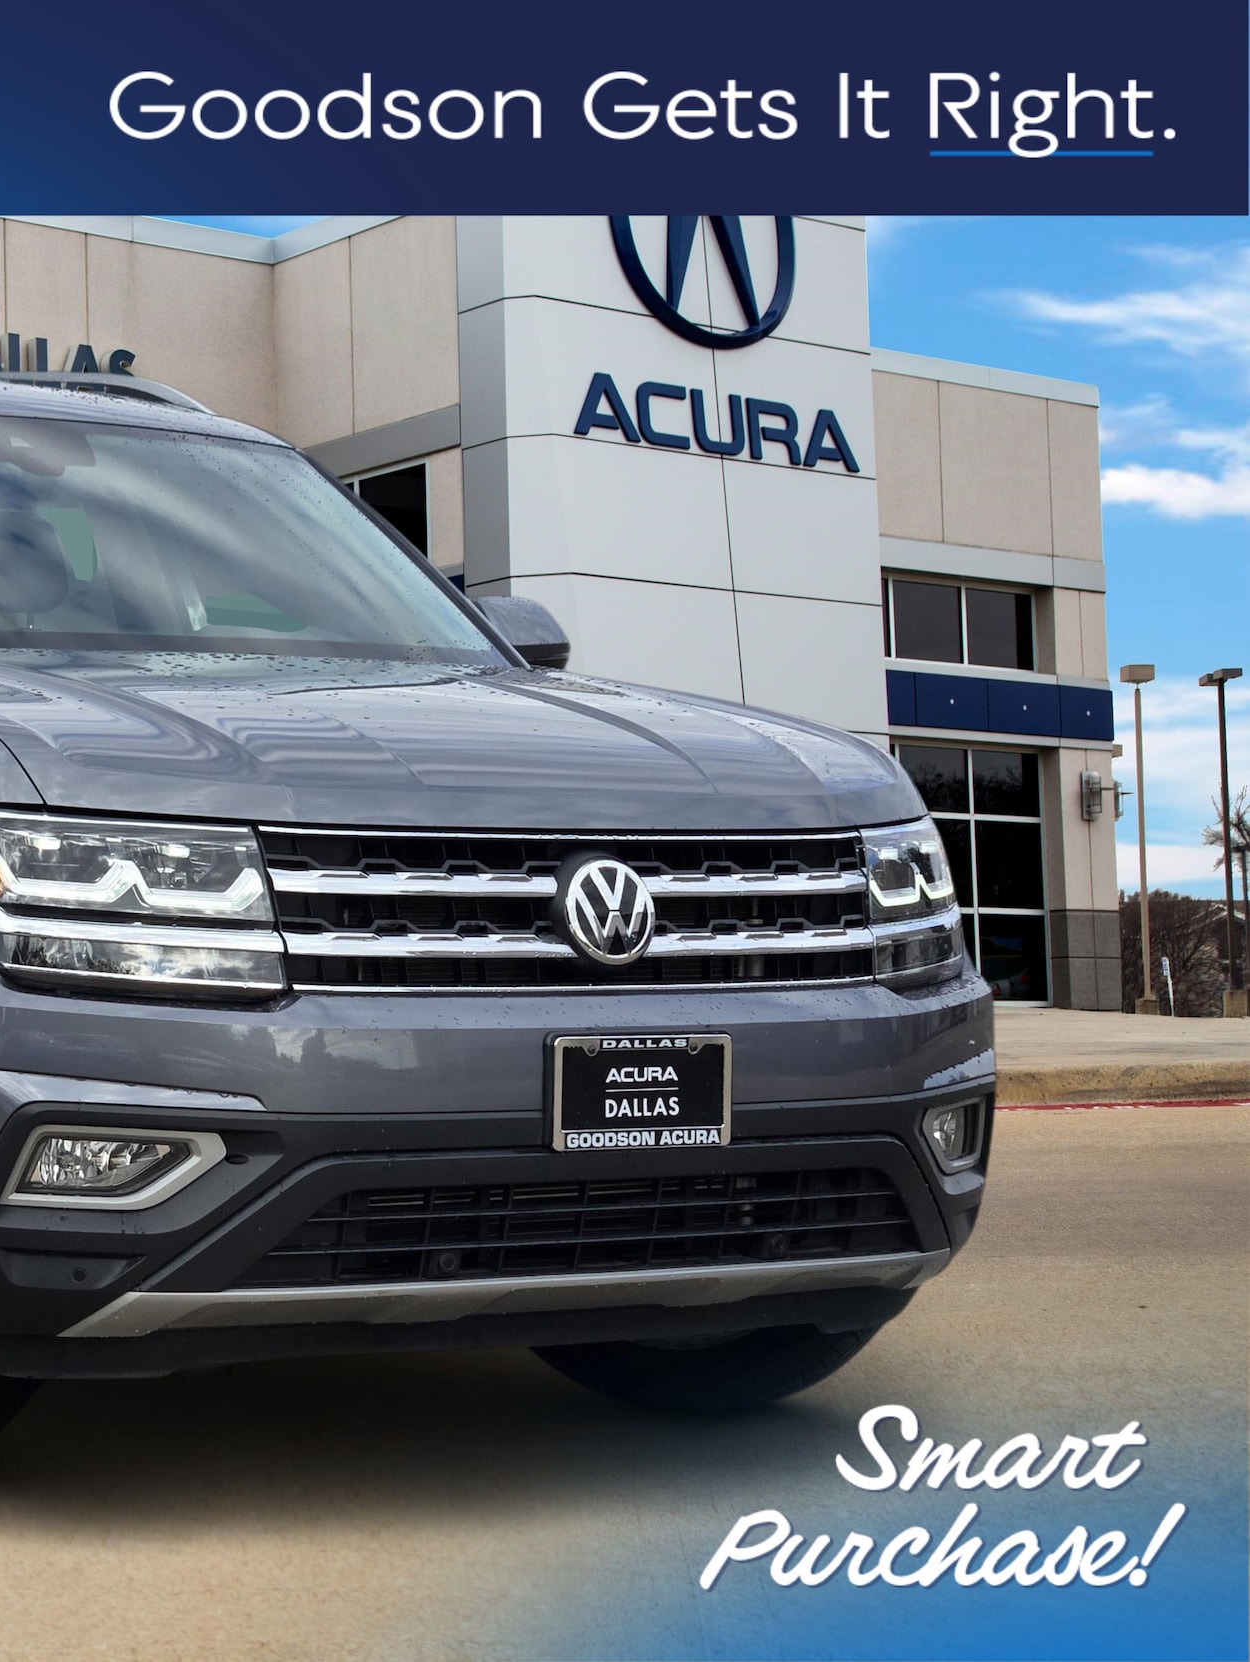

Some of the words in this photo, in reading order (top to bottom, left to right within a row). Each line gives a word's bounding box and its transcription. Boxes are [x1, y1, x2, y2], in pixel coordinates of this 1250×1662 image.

[574, 371, 860, 475] ACURA
[602, 1038, 689, 1049] DALLAS
[606, 1066, 679, 1083] ACURA
[605, 1096, 680, 1119] DALLAS
[566, 1131, 656, 1149] GOODSON
[659, 1129, 721, 1147] ACURA
